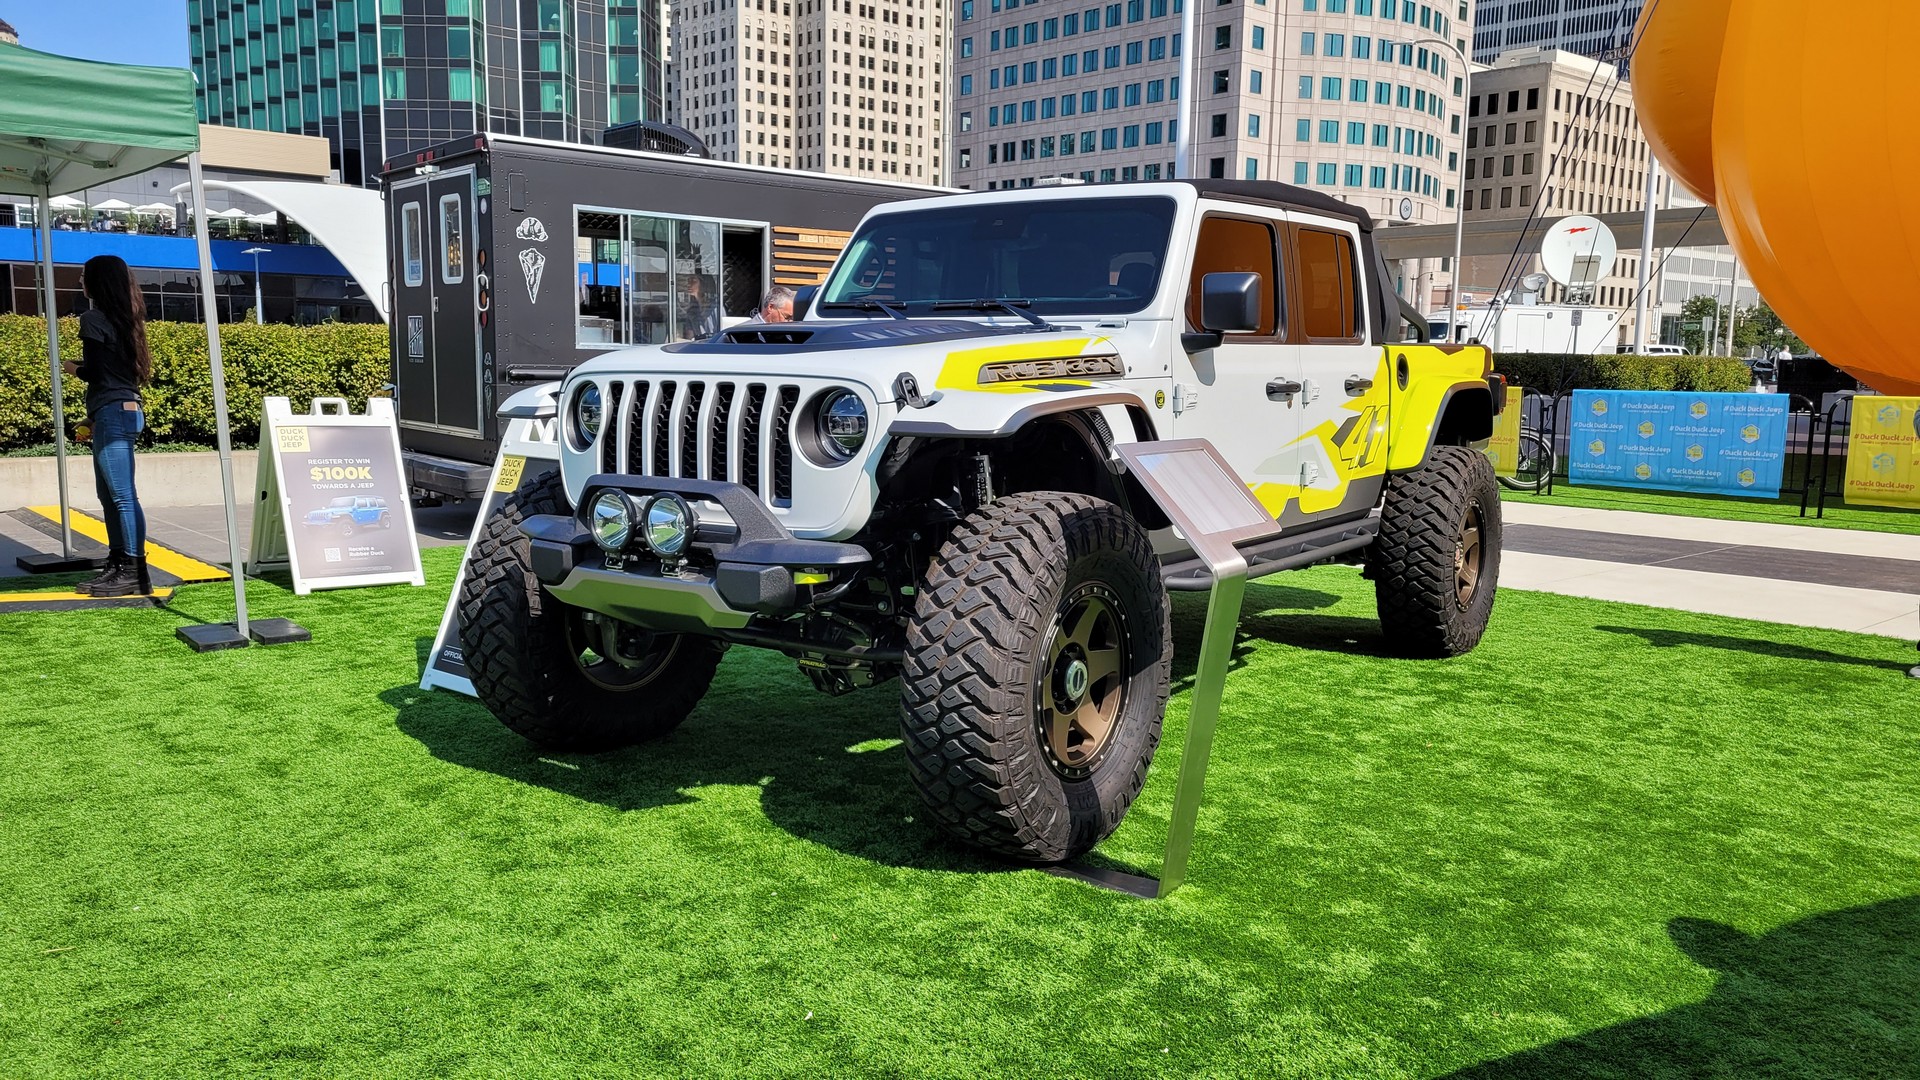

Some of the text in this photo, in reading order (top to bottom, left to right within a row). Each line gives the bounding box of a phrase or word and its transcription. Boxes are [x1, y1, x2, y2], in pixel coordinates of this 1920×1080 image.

[985, 356, 1122, 382] RUBICON
[503, 459, 522, 468] DUCK
[310, 466, 373, 482] $100K
[501, 468, 520, 477] DUCK
[497, 478, 514, 486] JEEP
